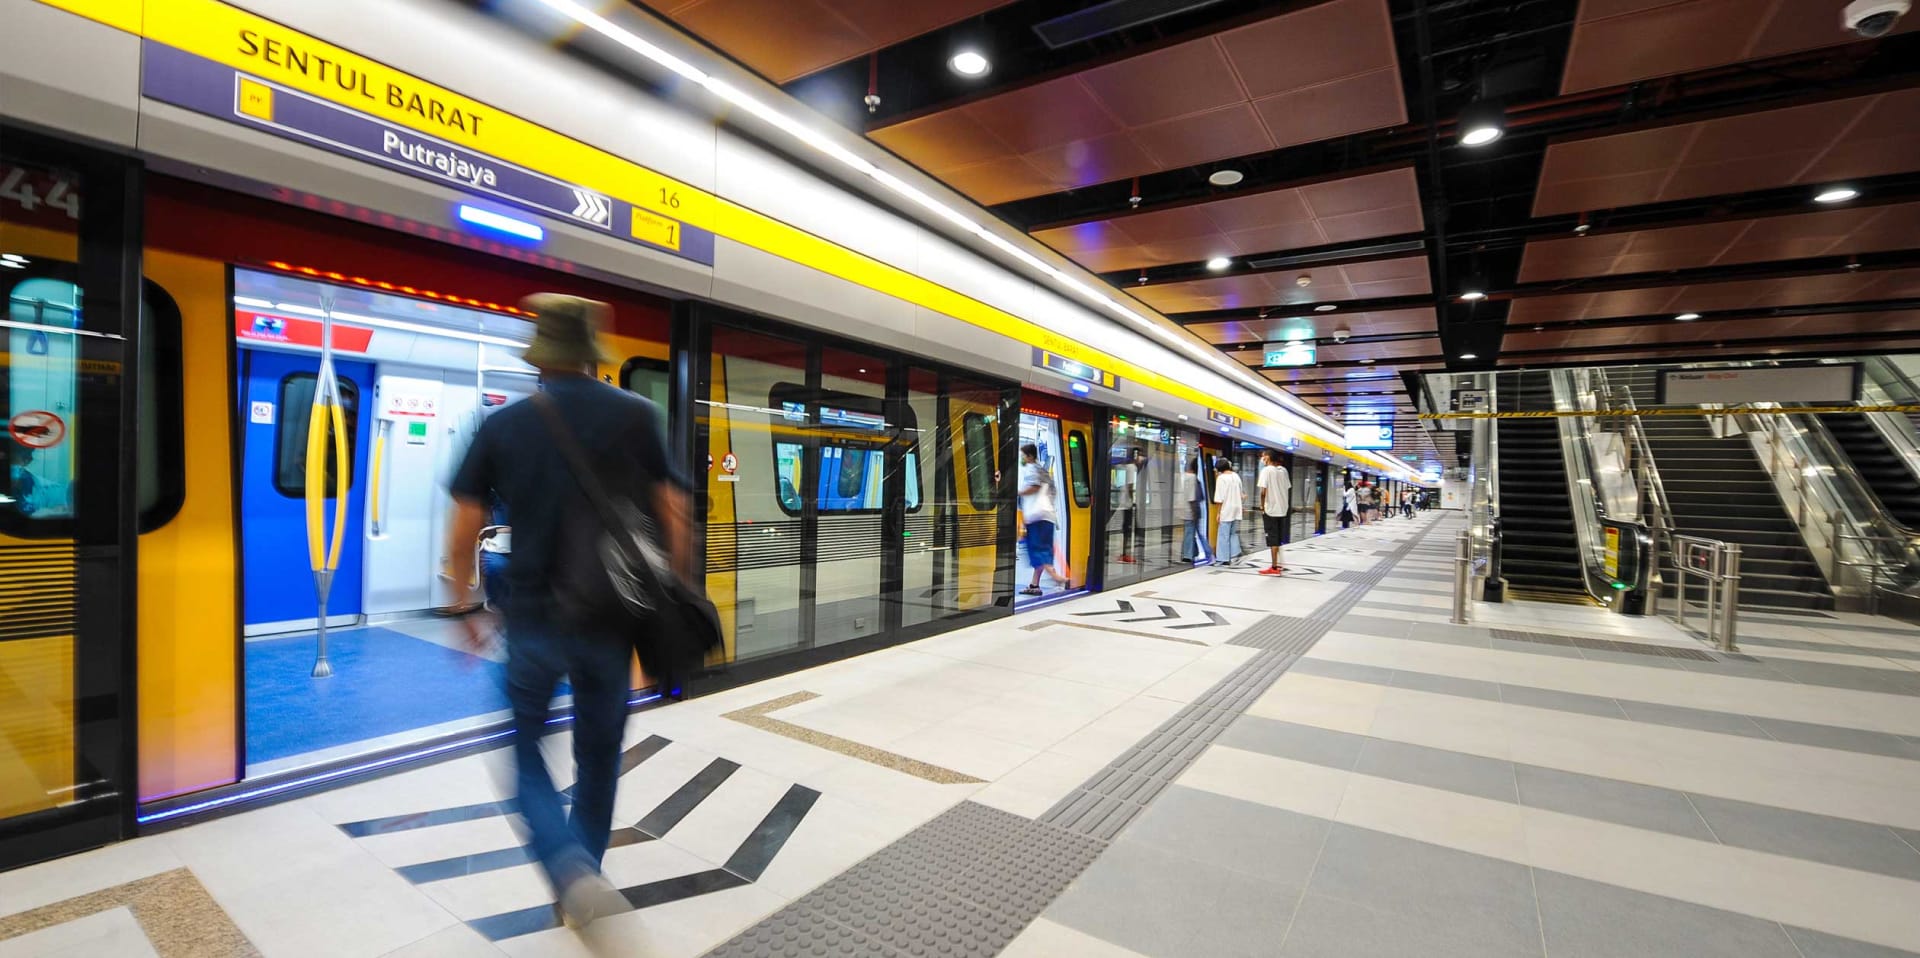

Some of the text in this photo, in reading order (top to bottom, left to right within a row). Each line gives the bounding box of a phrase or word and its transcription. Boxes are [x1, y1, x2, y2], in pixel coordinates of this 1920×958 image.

[238, 29, 483, 137] SENTUL BARAT
[383, 130, 497, 186] Putrajaya
[659, 186, 680, 209] 16
[666, 224, 675, 246] 1
